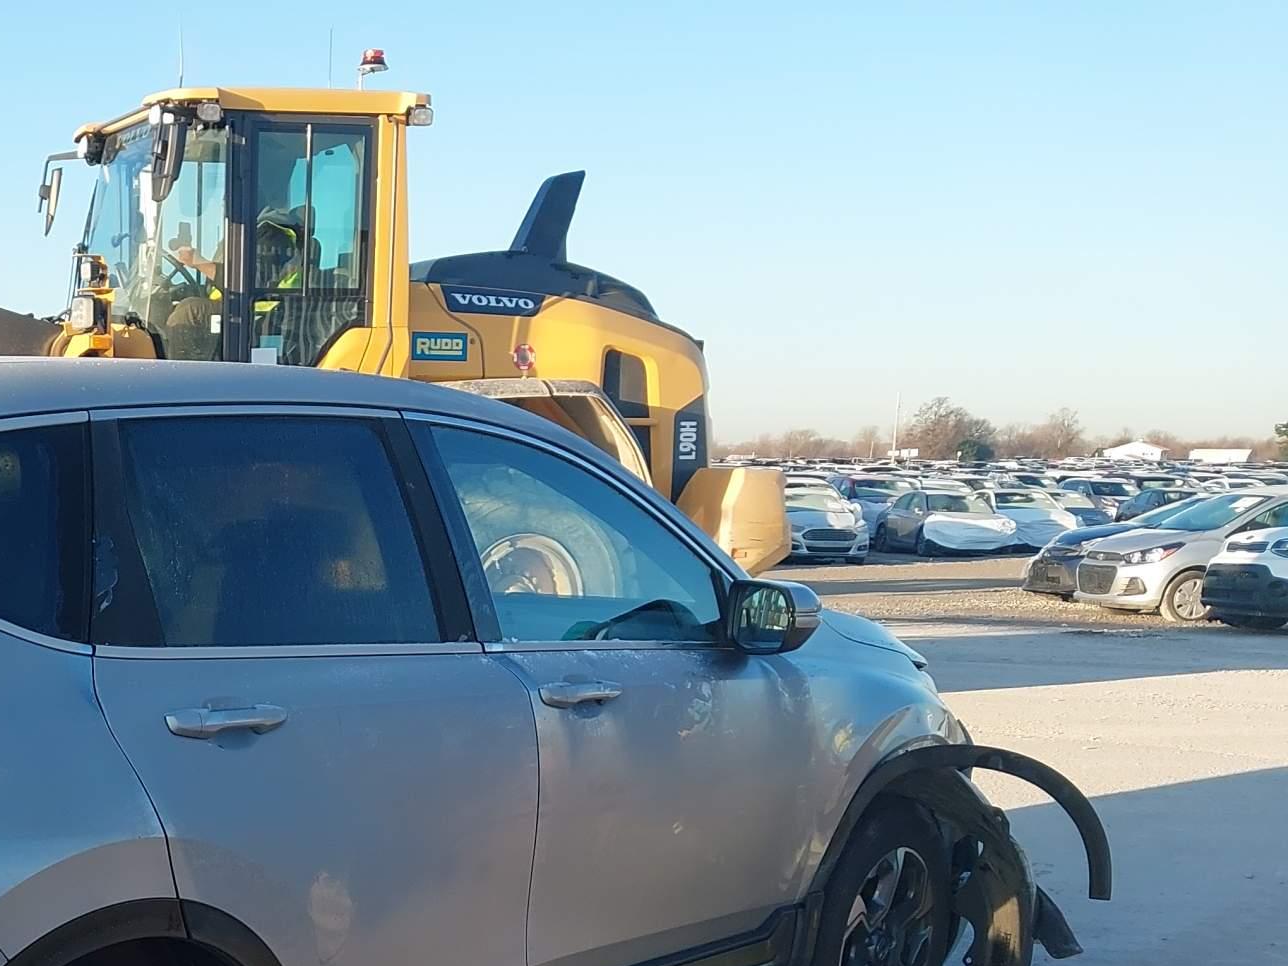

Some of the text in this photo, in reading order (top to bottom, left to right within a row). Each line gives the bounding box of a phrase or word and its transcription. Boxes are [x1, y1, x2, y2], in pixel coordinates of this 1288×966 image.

[450, 292, 535, 310] VOLVO
[415, 337, 464, 356] RUDD
[678, 421, 698, 460] L90H
